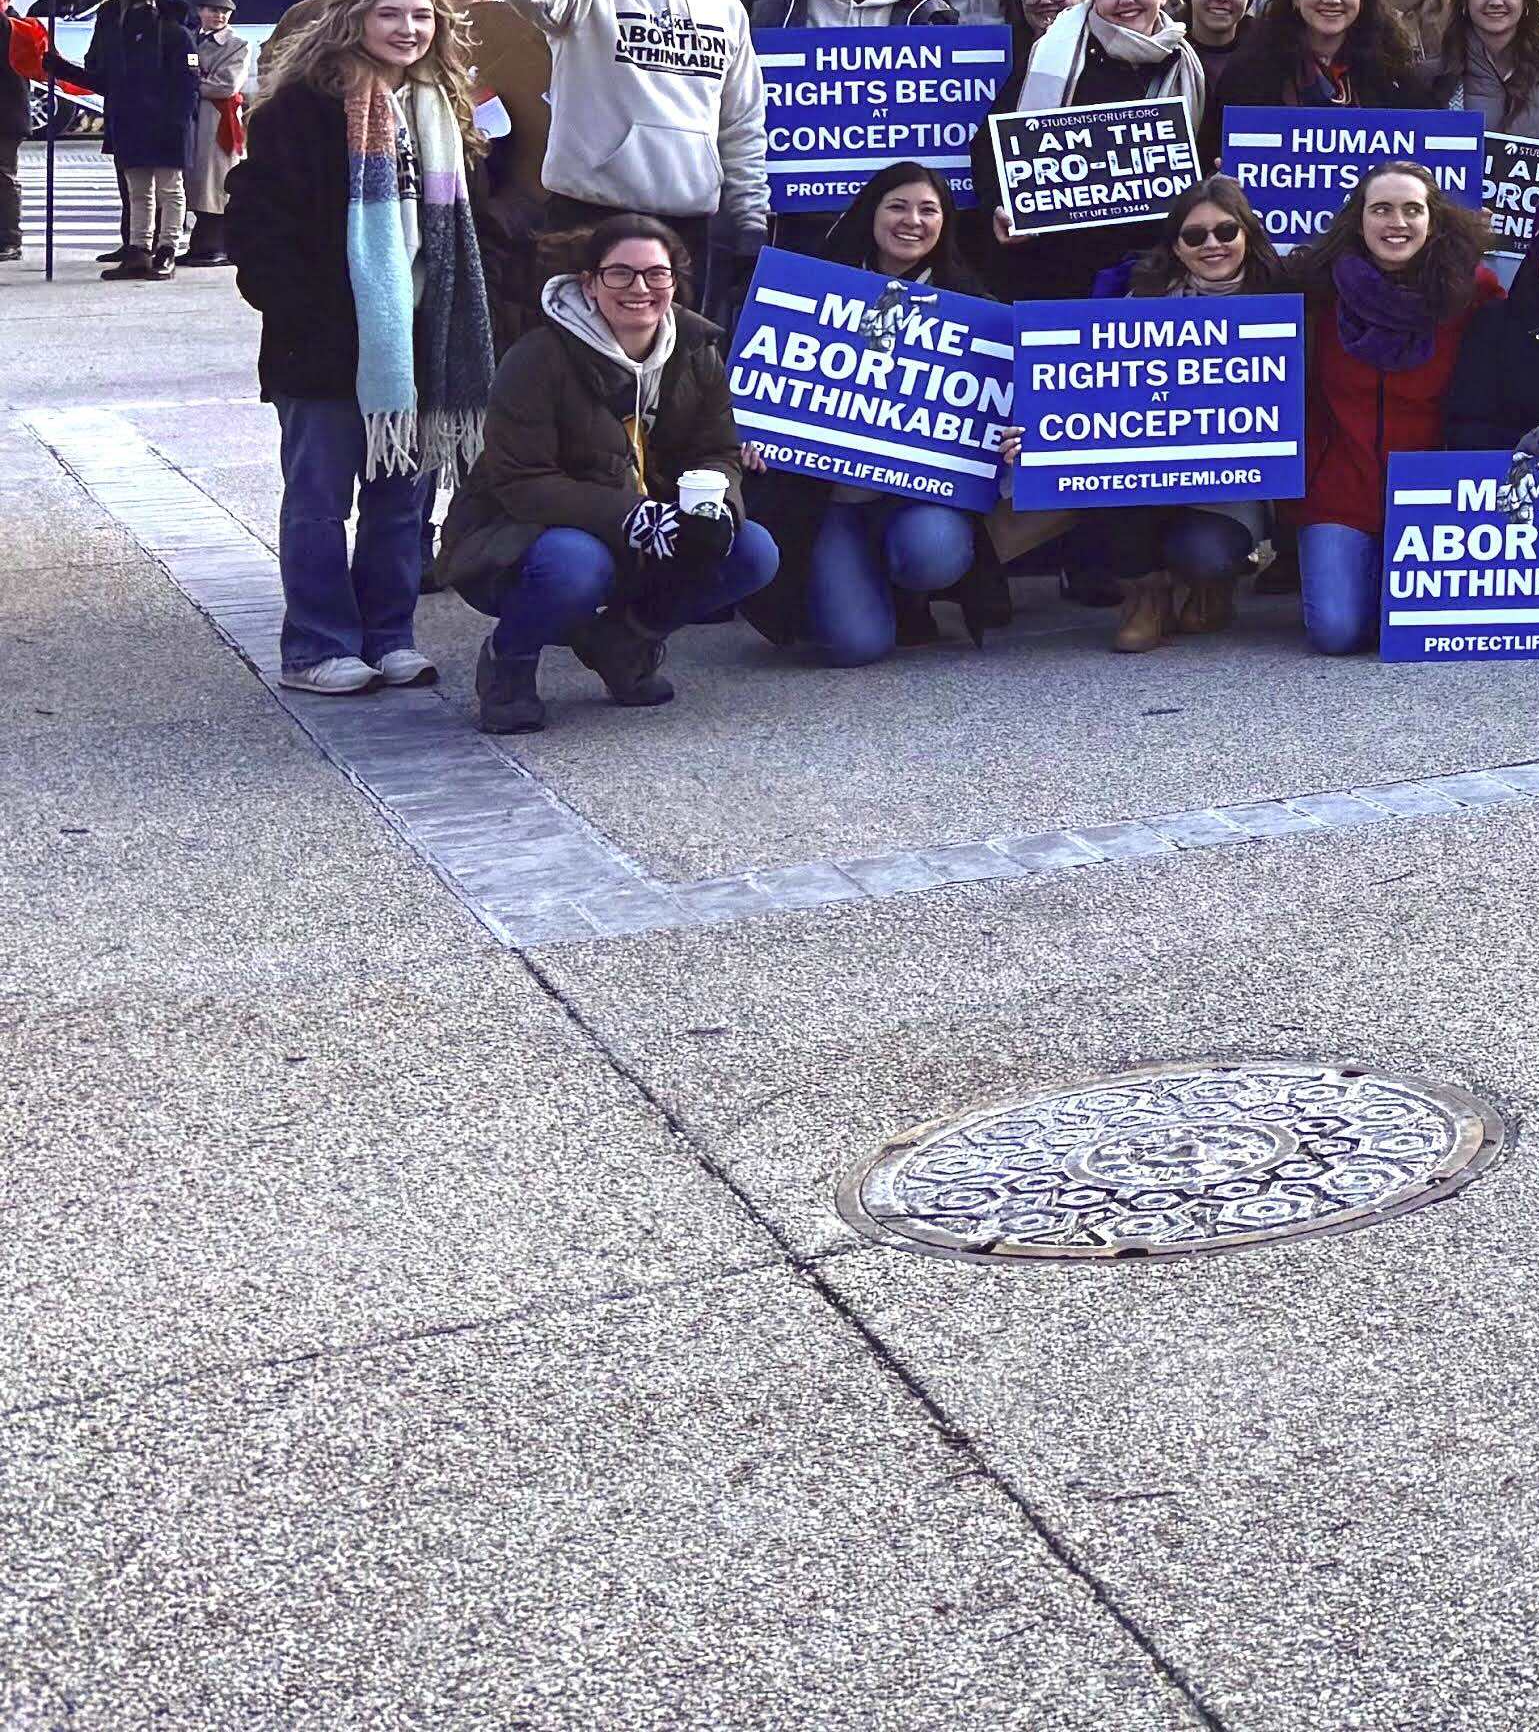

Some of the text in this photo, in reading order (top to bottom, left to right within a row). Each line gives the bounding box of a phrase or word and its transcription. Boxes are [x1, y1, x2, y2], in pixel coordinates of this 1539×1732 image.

[816, 45, 942, 71] HUMAN
[763, 78, 997, 107] RIGHTS BEGIN
[872, 108, 888, 118] AT
[1041, 107, 1159, 128] STUDENTSFORLIFE.ORG
[1010, 119, 1177, 156] I AM THE
[1291, 128, 1415, 155] HUMAN
[1005, 142, 1194, 189] PRO-LIFE
[1237, 163, 1360, 189] RIGHTS
[1484, 155, 1493, 174] I
[1014, 173, 1192, 214] GENERATION
[818, 293, 970, 357] MKE
[1092, 319, 1228, 349] HUMAN
[740, 325, 1014, 417] ABORTION
[1032, 355, 1286, 391] RIGHTS BEGIN
[729, 366, 1003, 452] UNTHINKABLE
[1151, 391, 1169, 402] AT
[1039, 405, 1279, 441] CONCEPTION
[750, 440, 954, 497] PROTECTLIFEMI.ORG
[1058, 469, 1262, 491] PROTECTLIFEMI.ORG
